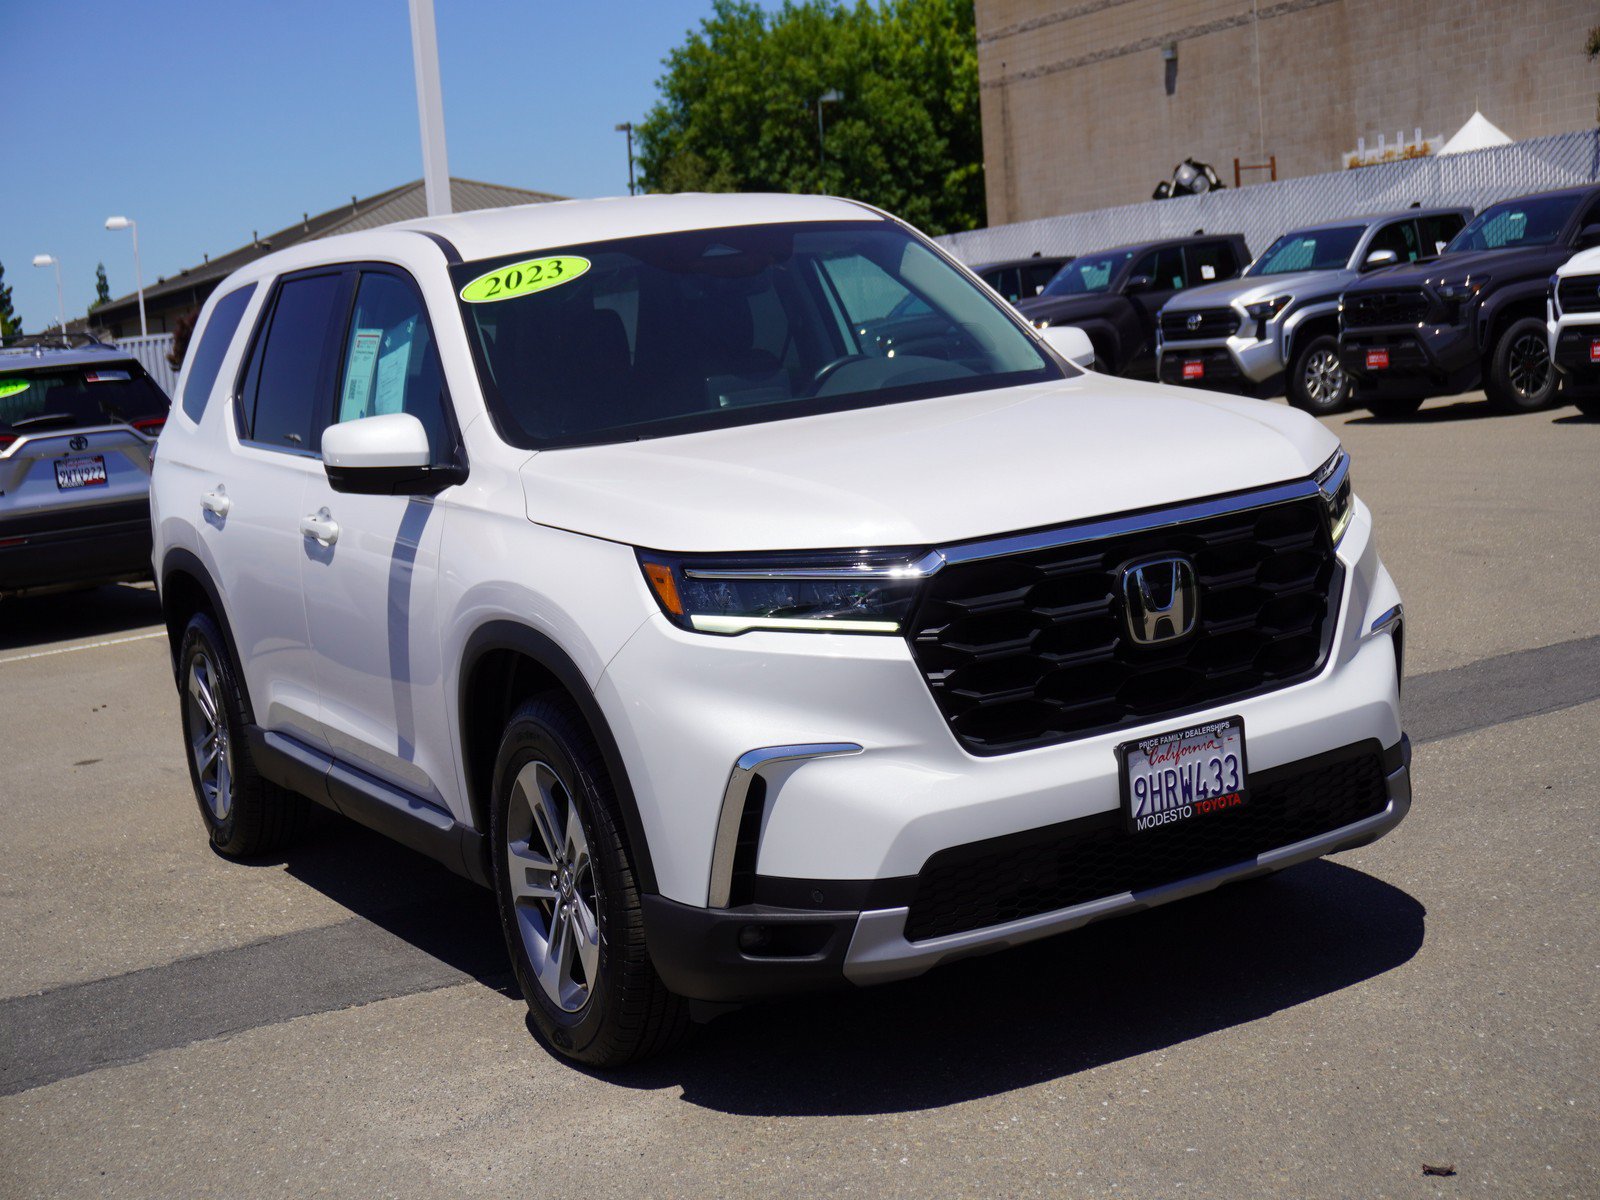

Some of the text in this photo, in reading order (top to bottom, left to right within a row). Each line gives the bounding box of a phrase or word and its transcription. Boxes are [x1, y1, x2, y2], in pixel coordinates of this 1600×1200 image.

[484, 260, 564, 298] 2023
[1138, 721, 1230, 749] PRICE FAMILY DEALERSHIPS
[1149, 738, 1222, 766] California
[1134, 754, 1239, 817] 9HRW433
[1137, 793, 1241, 831] MODESTO TOYOTA
